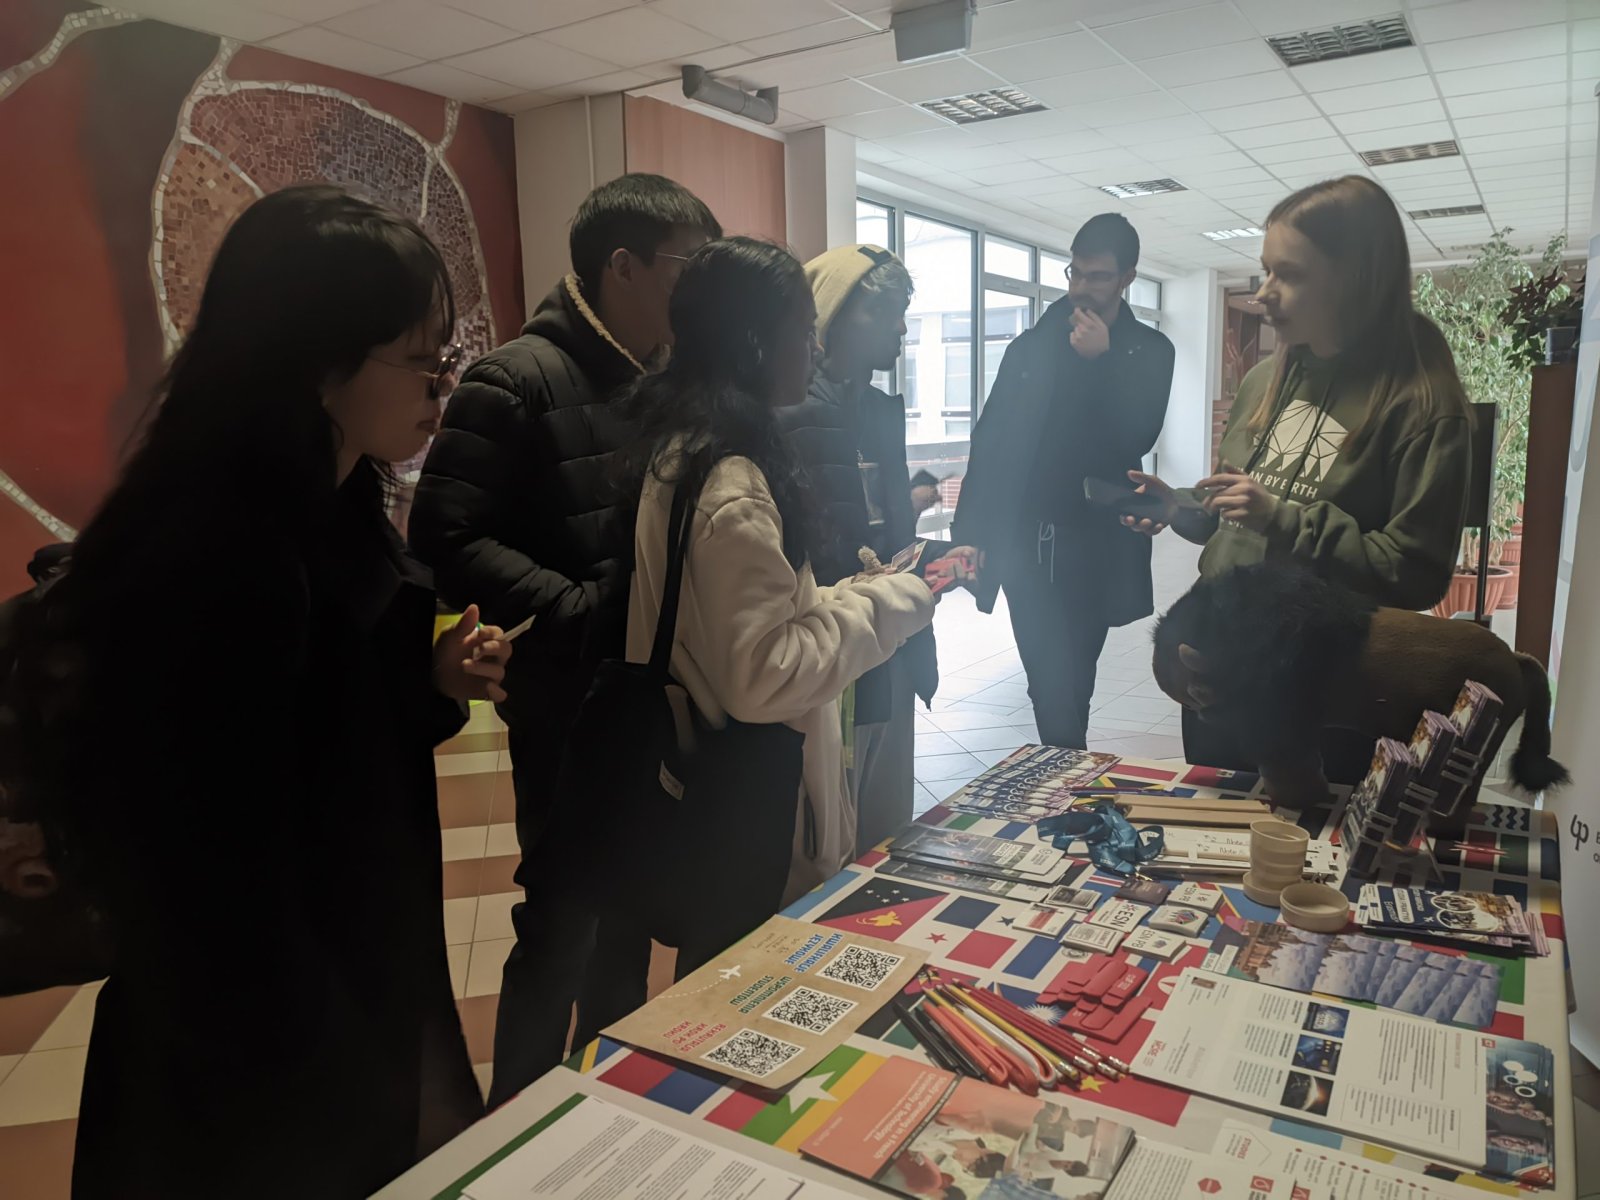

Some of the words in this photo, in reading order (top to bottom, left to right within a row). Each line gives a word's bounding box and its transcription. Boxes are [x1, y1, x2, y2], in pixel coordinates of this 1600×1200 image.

[1264, 475, 1280, 488] BY
[1280, 479, 1318, 499] ERTH
[1110, 911, 1134, 928] ESN
[1132, 940, 1146, 948] PB
[1138, 929, 1156, 940] ESN
[784, 934, 824, 965] JĘZYKOWE
[738, 976, 793, 1014] WSPOMNIENIA
[663, 1021, 693, 1038] KROKU
[672, 1036, 687, 1045] PO
[680, 1023, 727, 1052] REKRUTACJA
[687, 1022, 709, 1037] KROK
[906, 1073, 937, 1102] University
[927, 1076, 948, 1094] Study
[898, 1093, 934, 1129] engineering
[872, 1108, 907, 1142] Technology
[873, 1137, 897, 1159] French
